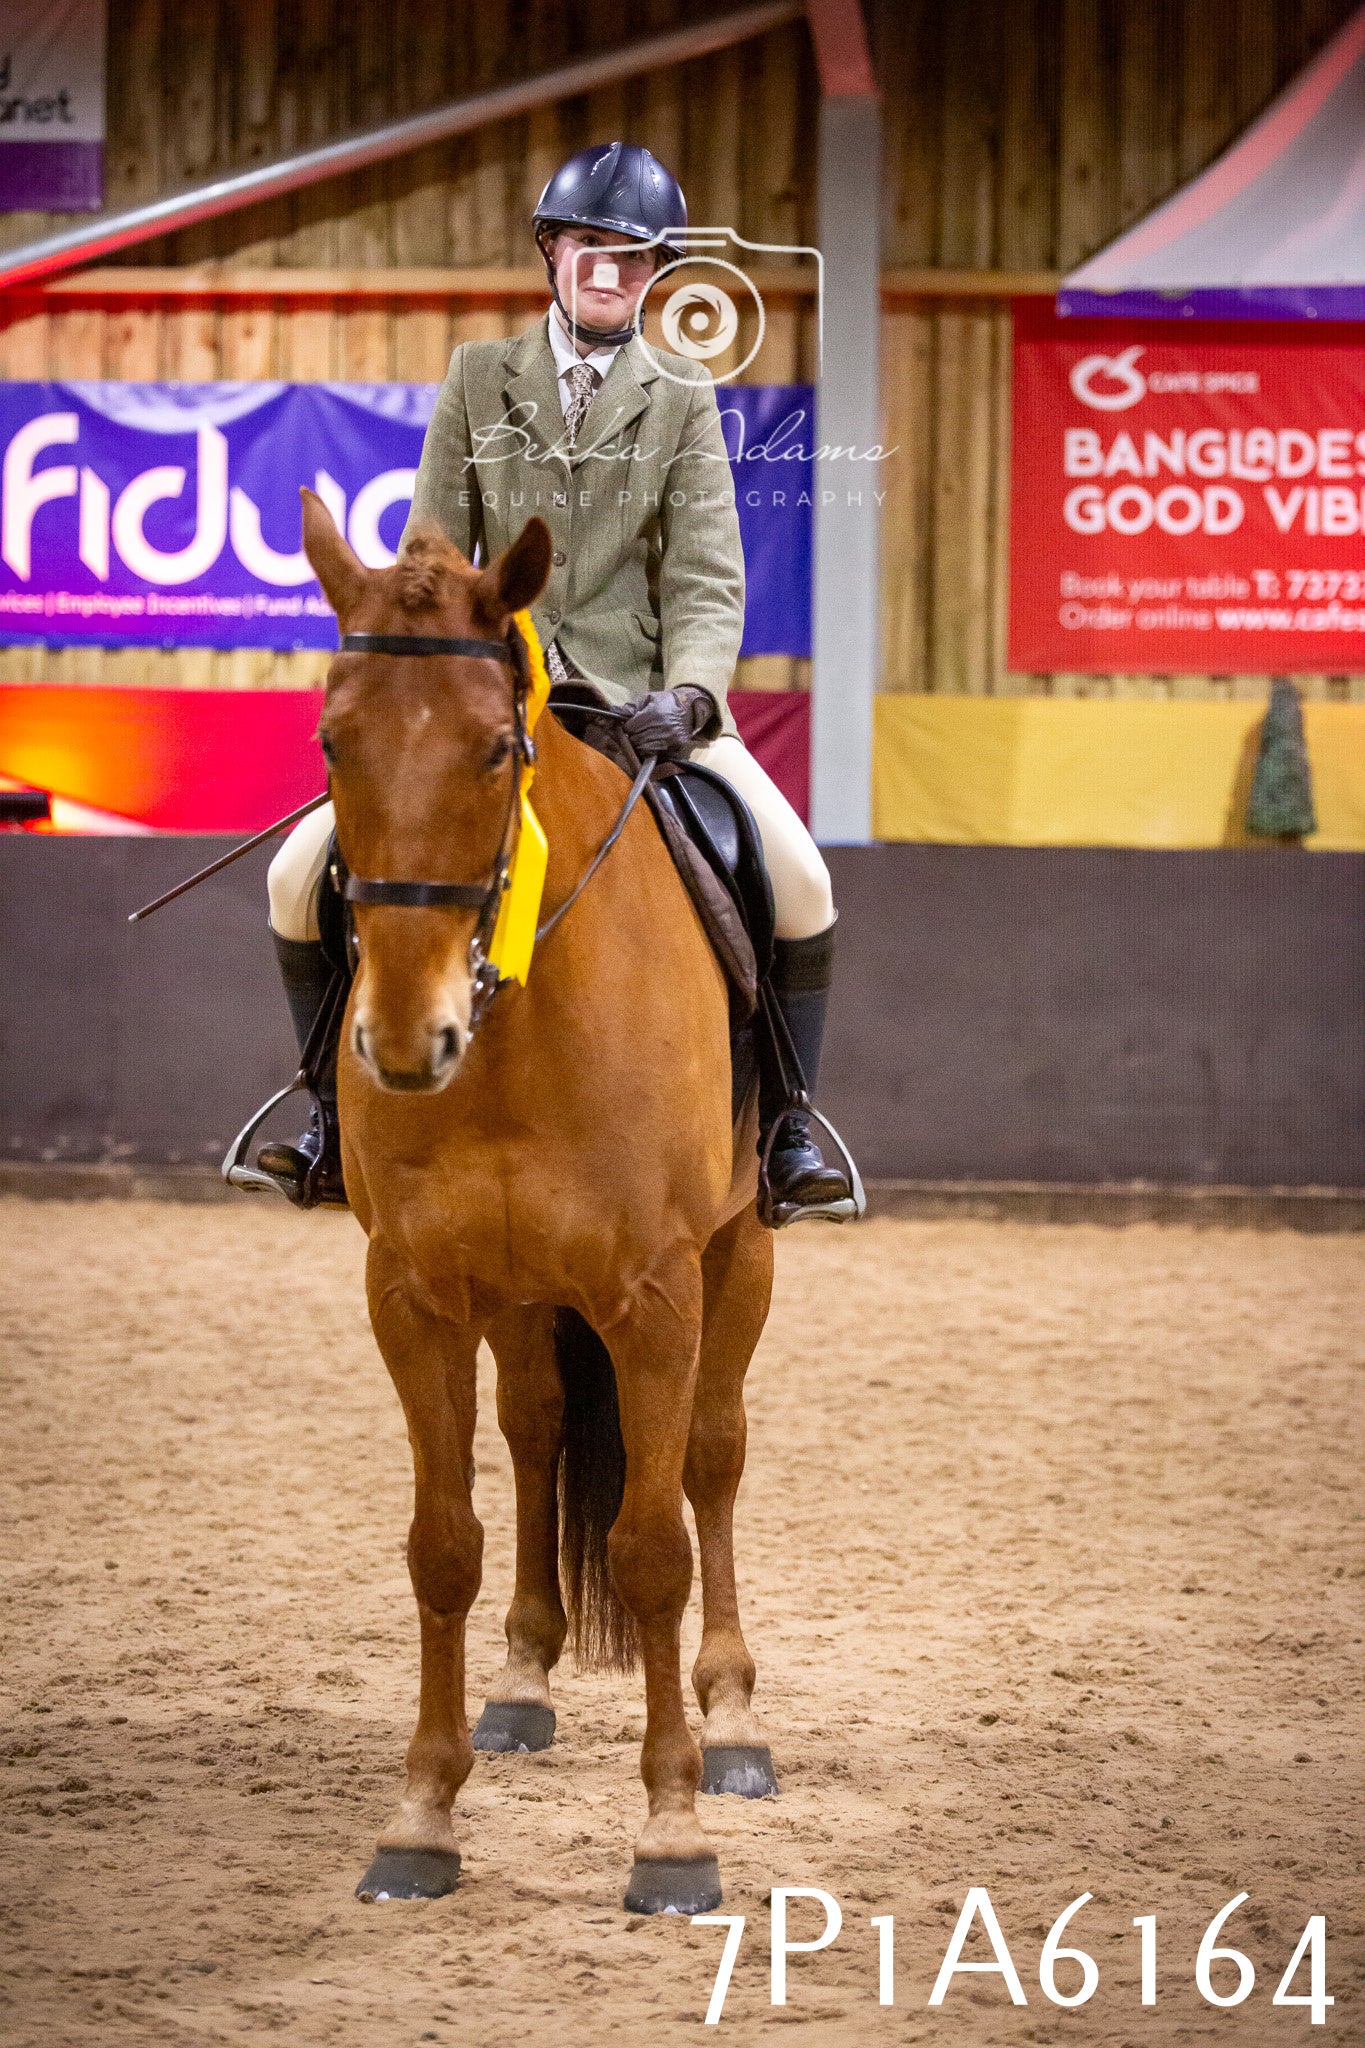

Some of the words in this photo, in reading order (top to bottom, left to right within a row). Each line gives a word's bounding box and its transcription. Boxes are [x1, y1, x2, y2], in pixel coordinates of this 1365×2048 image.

[1063, 484, 1246, 536] GOOD
[1262, 484, 1365, 536] VIB
[1060, 570, 1123, 600] Book
[1126, 576, 1182, 605] your
[1185, 570, 1250, 600] table
[1058, 601, 1132, 631] Order
[1135, 602, 1213, 630] online
